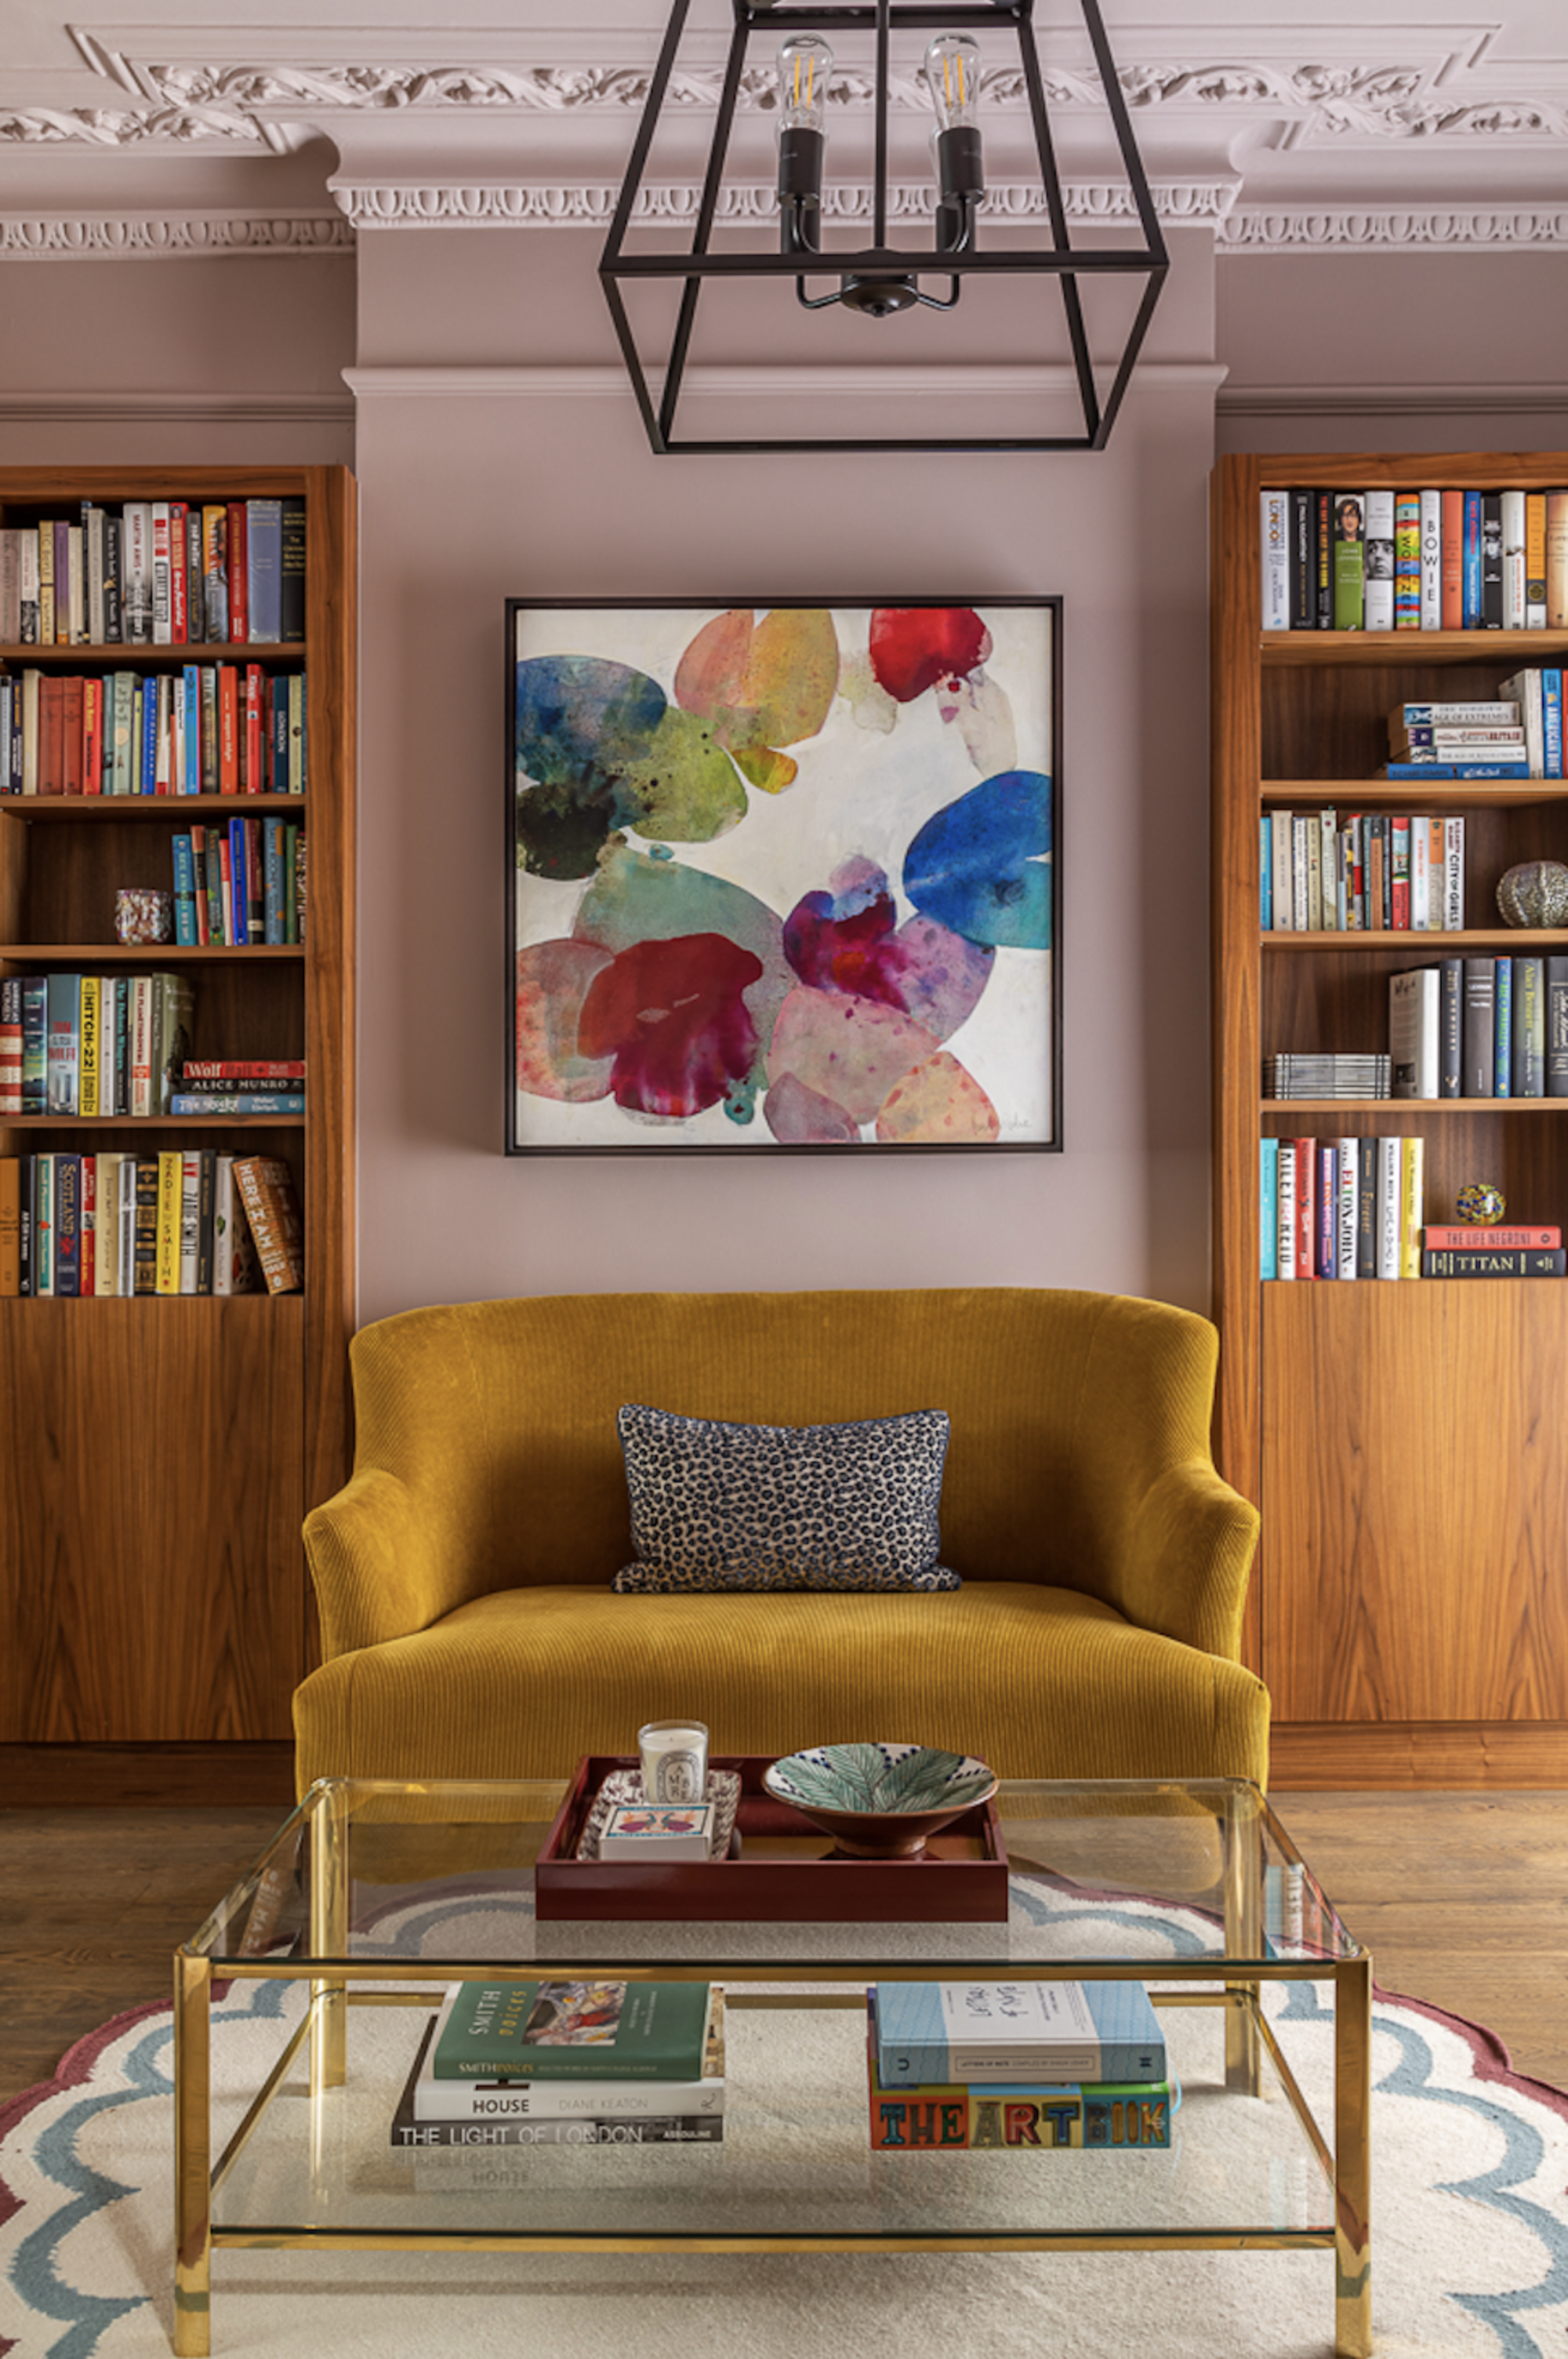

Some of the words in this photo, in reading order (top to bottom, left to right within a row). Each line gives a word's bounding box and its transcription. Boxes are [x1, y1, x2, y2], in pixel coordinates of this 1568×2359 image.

[1269, 500, 1279, 551] LONDON
[1450, 855, 1460, 878] CITY
[1450, 880, 1458, 889] OF
[1450, 892, 1460, 923] GIRLS
[1525, 965, 1535, 989] Alan
[1525, 991, 1535, 1029] Bennett
[84, 996, 95, 1068] HITCH-22
[188, 1063, 222, 1077] Wolf
[192, 1081, 234, 1090] ALICE
[238, 1080, 289, 1089] MUNRO
[238, 1164, 262, 1206] HERE
[1341, 1170, 1353, 1218] ELTON
[63, 1164, 76, 1234] SCOTLAND
[1361, 1191, 1374, 1234] Forever
[251, 1209, 265, 1221] I
[255, 1225, 273, 1248] AM
[1341, 1219, 1354, 1265] JOHN
[1446, 1232, 1464, 1245] THE
[1467, 1232, 1485, 1245] LIFE
[1489, 1232, 1531, 1245] NEGRONI
[1457, 1256, 1514, 1270] TITAN
[467, 1990, 502, 2035] SMITH
[472, 2099, 530, 2114] HOUSE
[558, 2099, 597, 2110] DIANE
[601, 2098, 648, 2110] KEATON
[399, 2127, 441, 2146] THE
[448, 2126, 510, 2146] LIGHT
[517, 2125, 547, 2145] OF
[555, 2125, 643, 2145] LONDON
[662, 2129, 712, 2139] ASSOULINE
[879, 2103, 966, 2146] THE
[970, 2100, 1080, 2147] ART
[1085, 2100, 1166, 2145] BOOK
